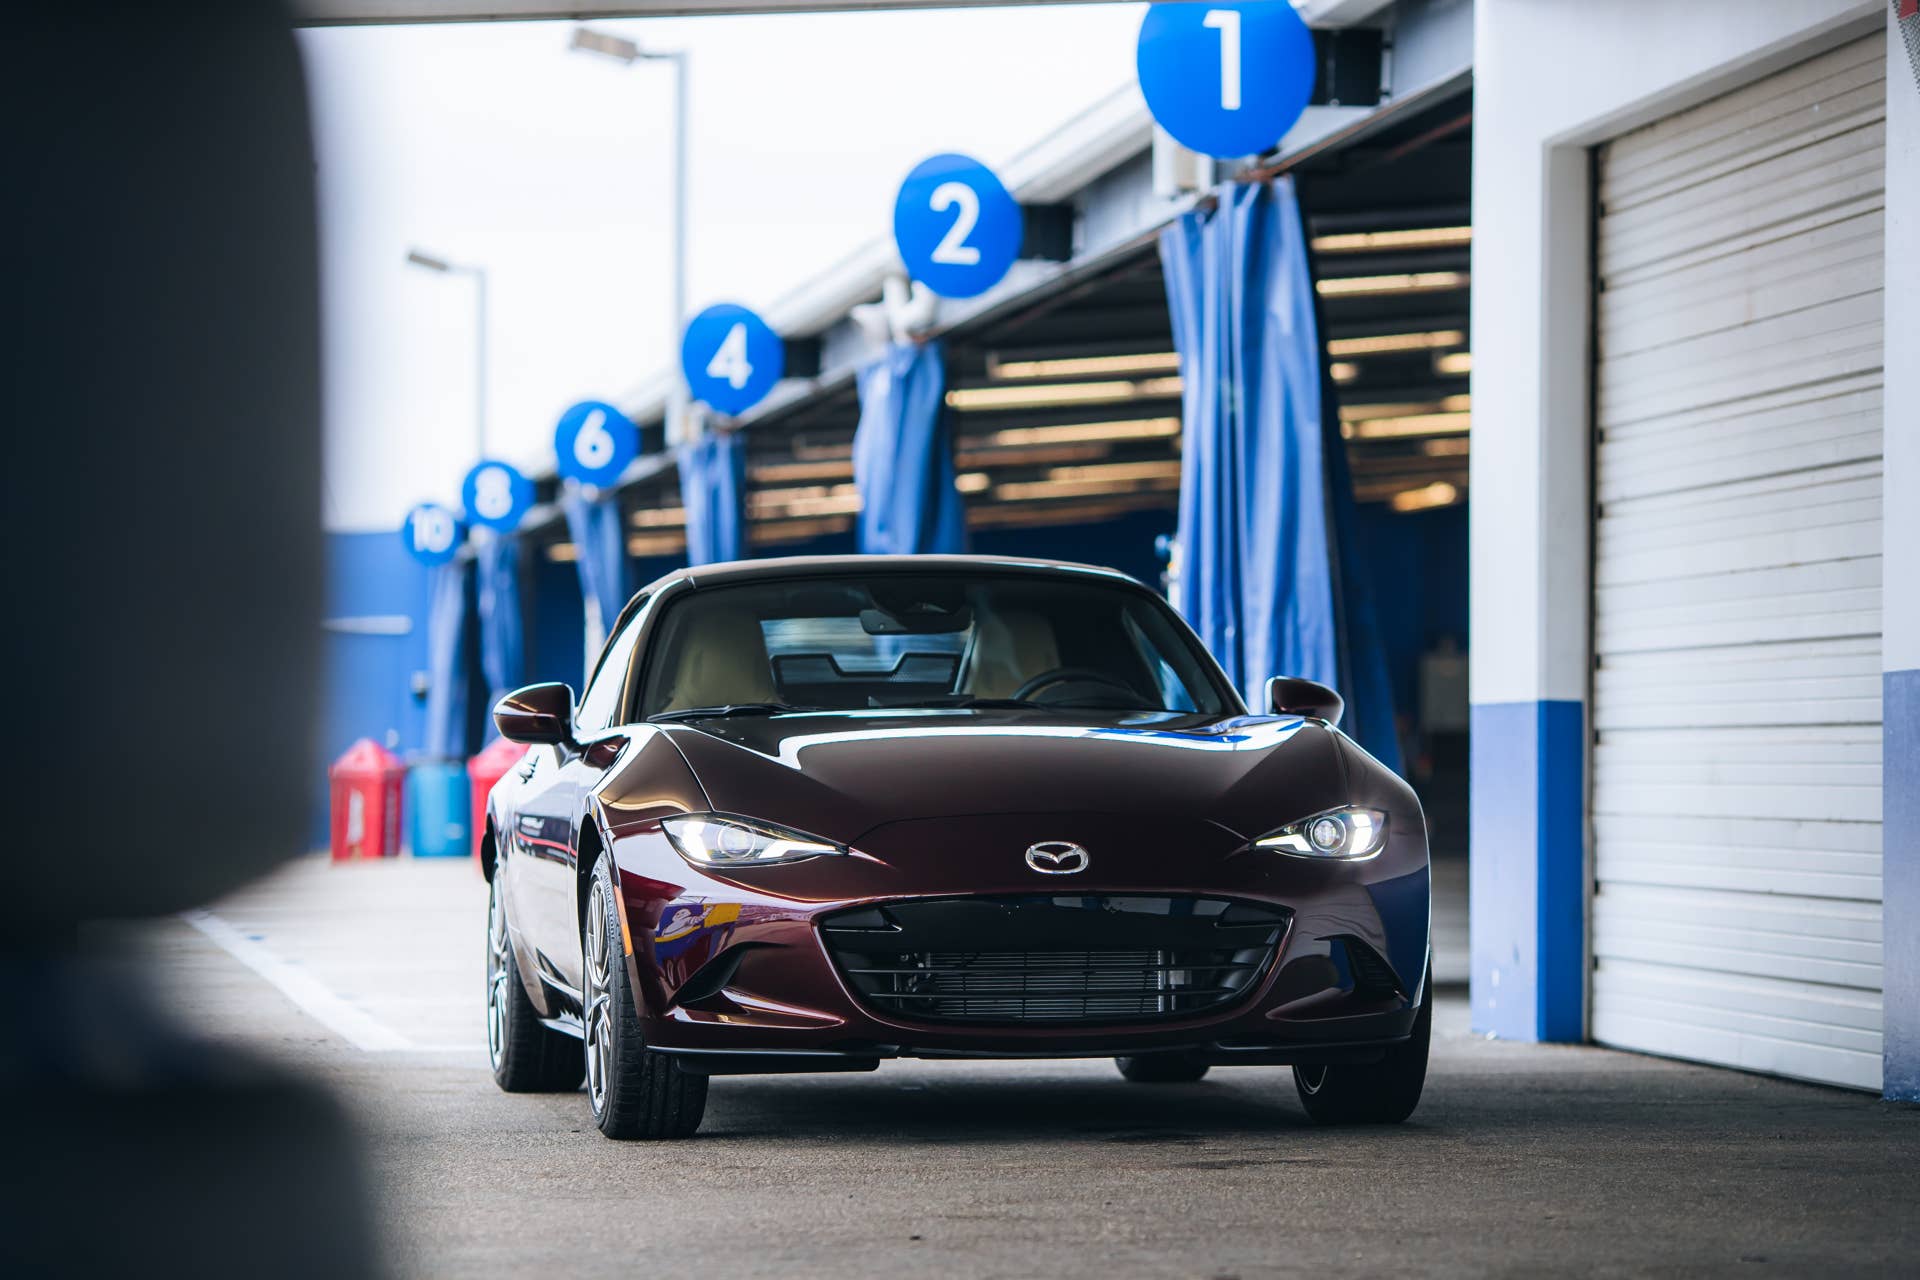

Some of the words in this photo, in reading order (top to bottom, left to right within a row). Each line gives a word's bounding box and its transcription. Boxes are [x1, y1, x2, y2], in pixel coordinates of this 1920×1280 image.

[1203, 9, 1241, 110] 1
[930, 182, 979, 265] 2
[708, 324, 751, 388] 4
[575, 410, 613, 468] 6
[476, 467, 512, 518] 8
[411, 509, 454, 552] 10
[602, 873, 615, 940] BRIDGETONE
